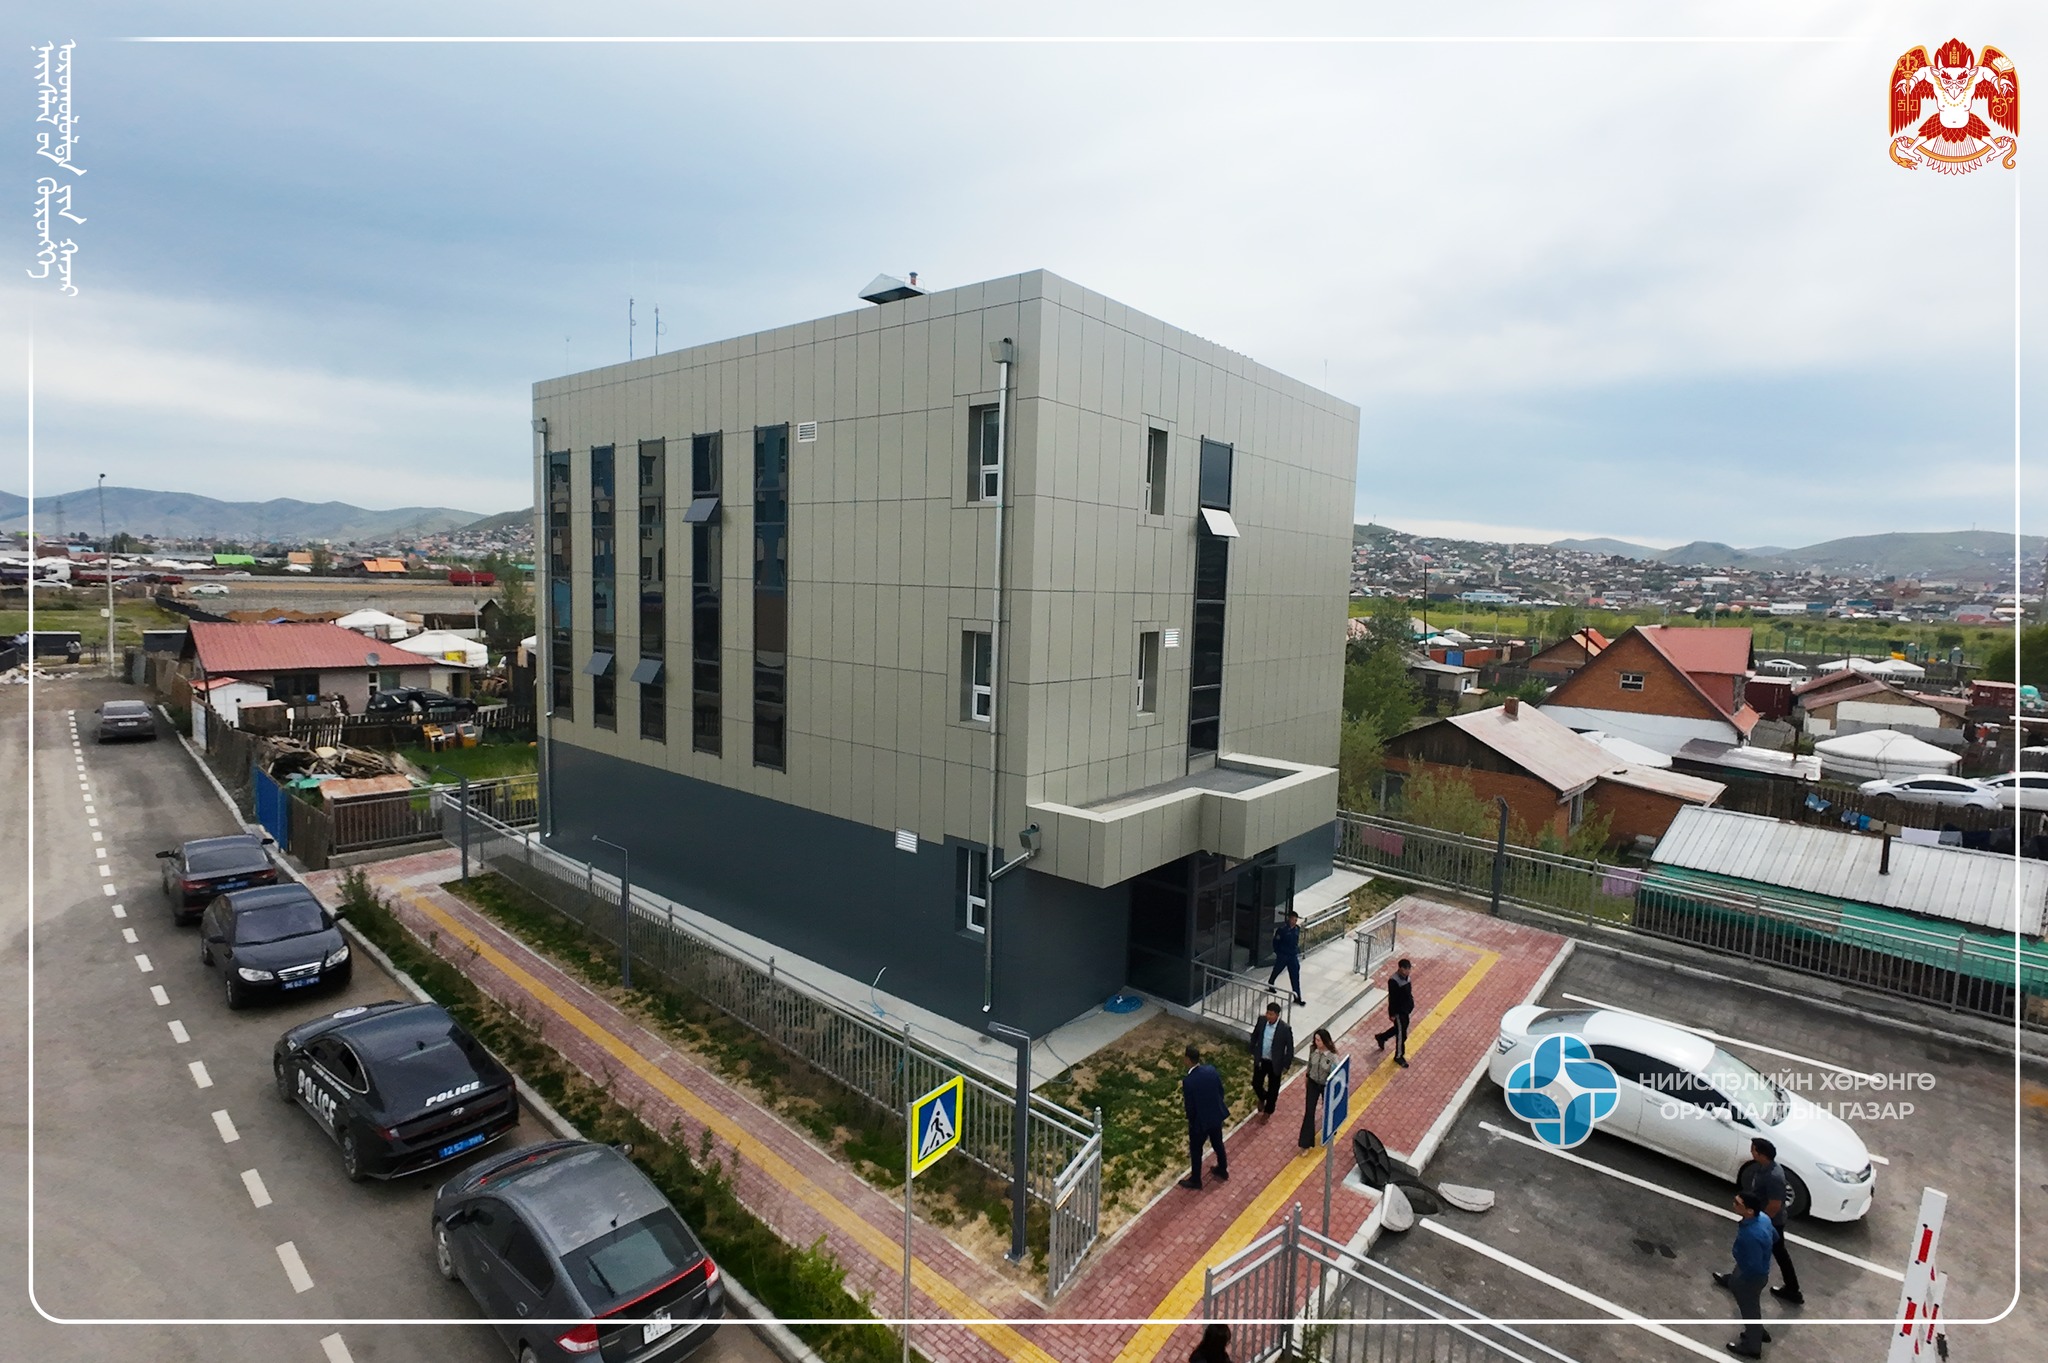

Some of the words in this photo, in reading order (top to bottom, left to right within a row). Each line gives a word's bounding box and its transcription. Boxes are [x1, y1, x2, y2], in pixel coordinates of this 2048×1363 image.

[298, 1068, 337, 1128] POLICE
[425, 1080, 480, 1107] POLICE
[1326, 1069, 1347, 1138] P
